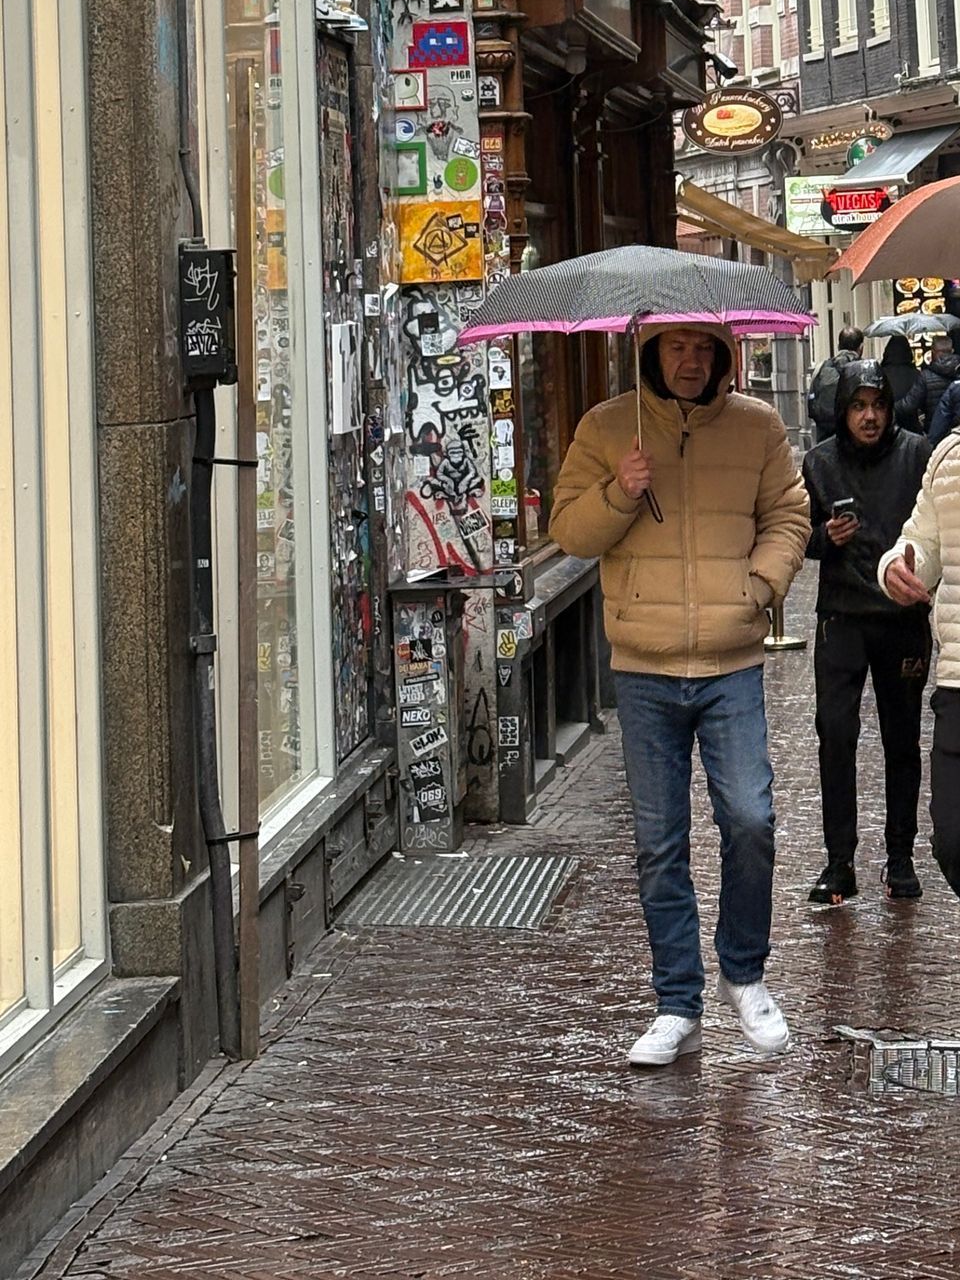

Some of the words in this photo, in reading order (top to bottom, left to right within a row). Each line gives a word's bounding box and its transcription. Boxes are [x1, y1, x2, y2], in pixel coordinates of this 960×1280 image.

[837, 194, 876, 210] VEGAS
[402, 708, 431, 722] NEKO
[421, 788, 441, 803] 069
